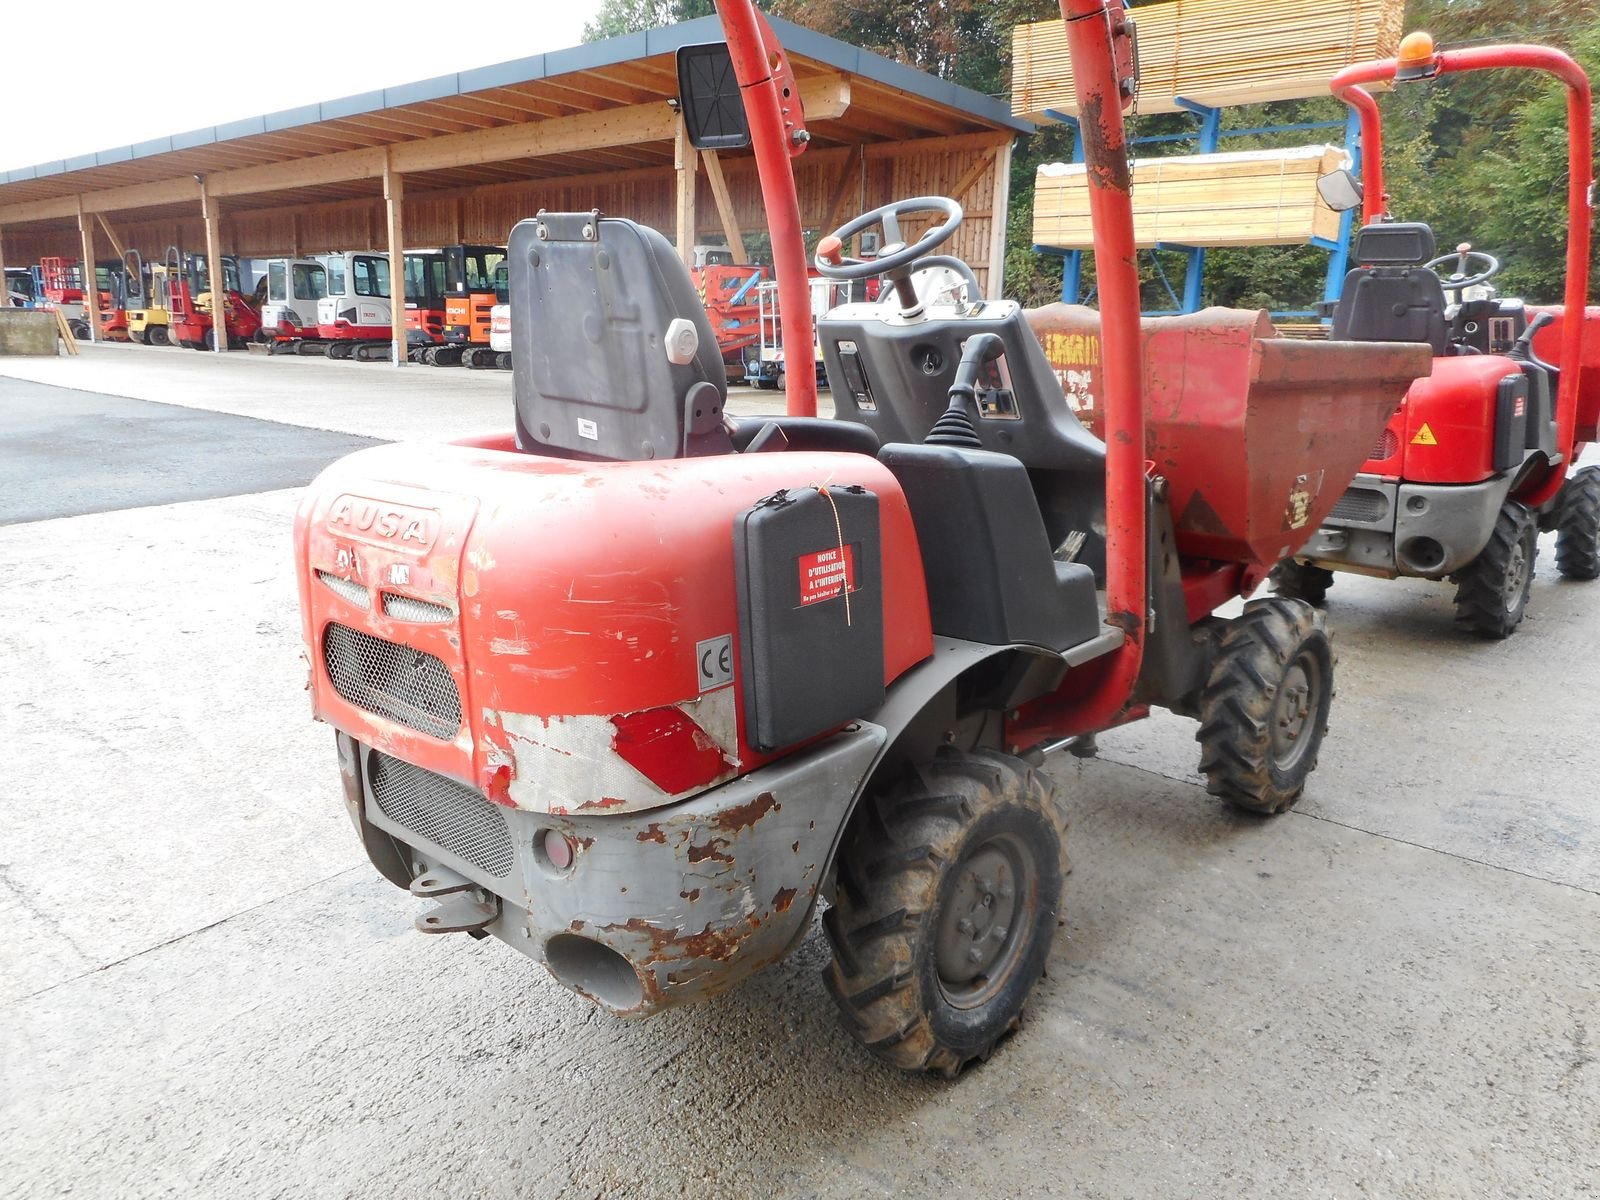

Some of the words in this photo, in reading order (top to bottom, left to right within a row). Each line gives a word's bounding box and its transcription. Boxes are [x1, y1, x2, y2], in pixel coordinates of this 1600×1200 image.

[330, 503, 428, 545] AUSA
[817, 551, 836, 563] NOTICE
[809, 581, 814, 590] A
[701, 644, 730, 679] CE
